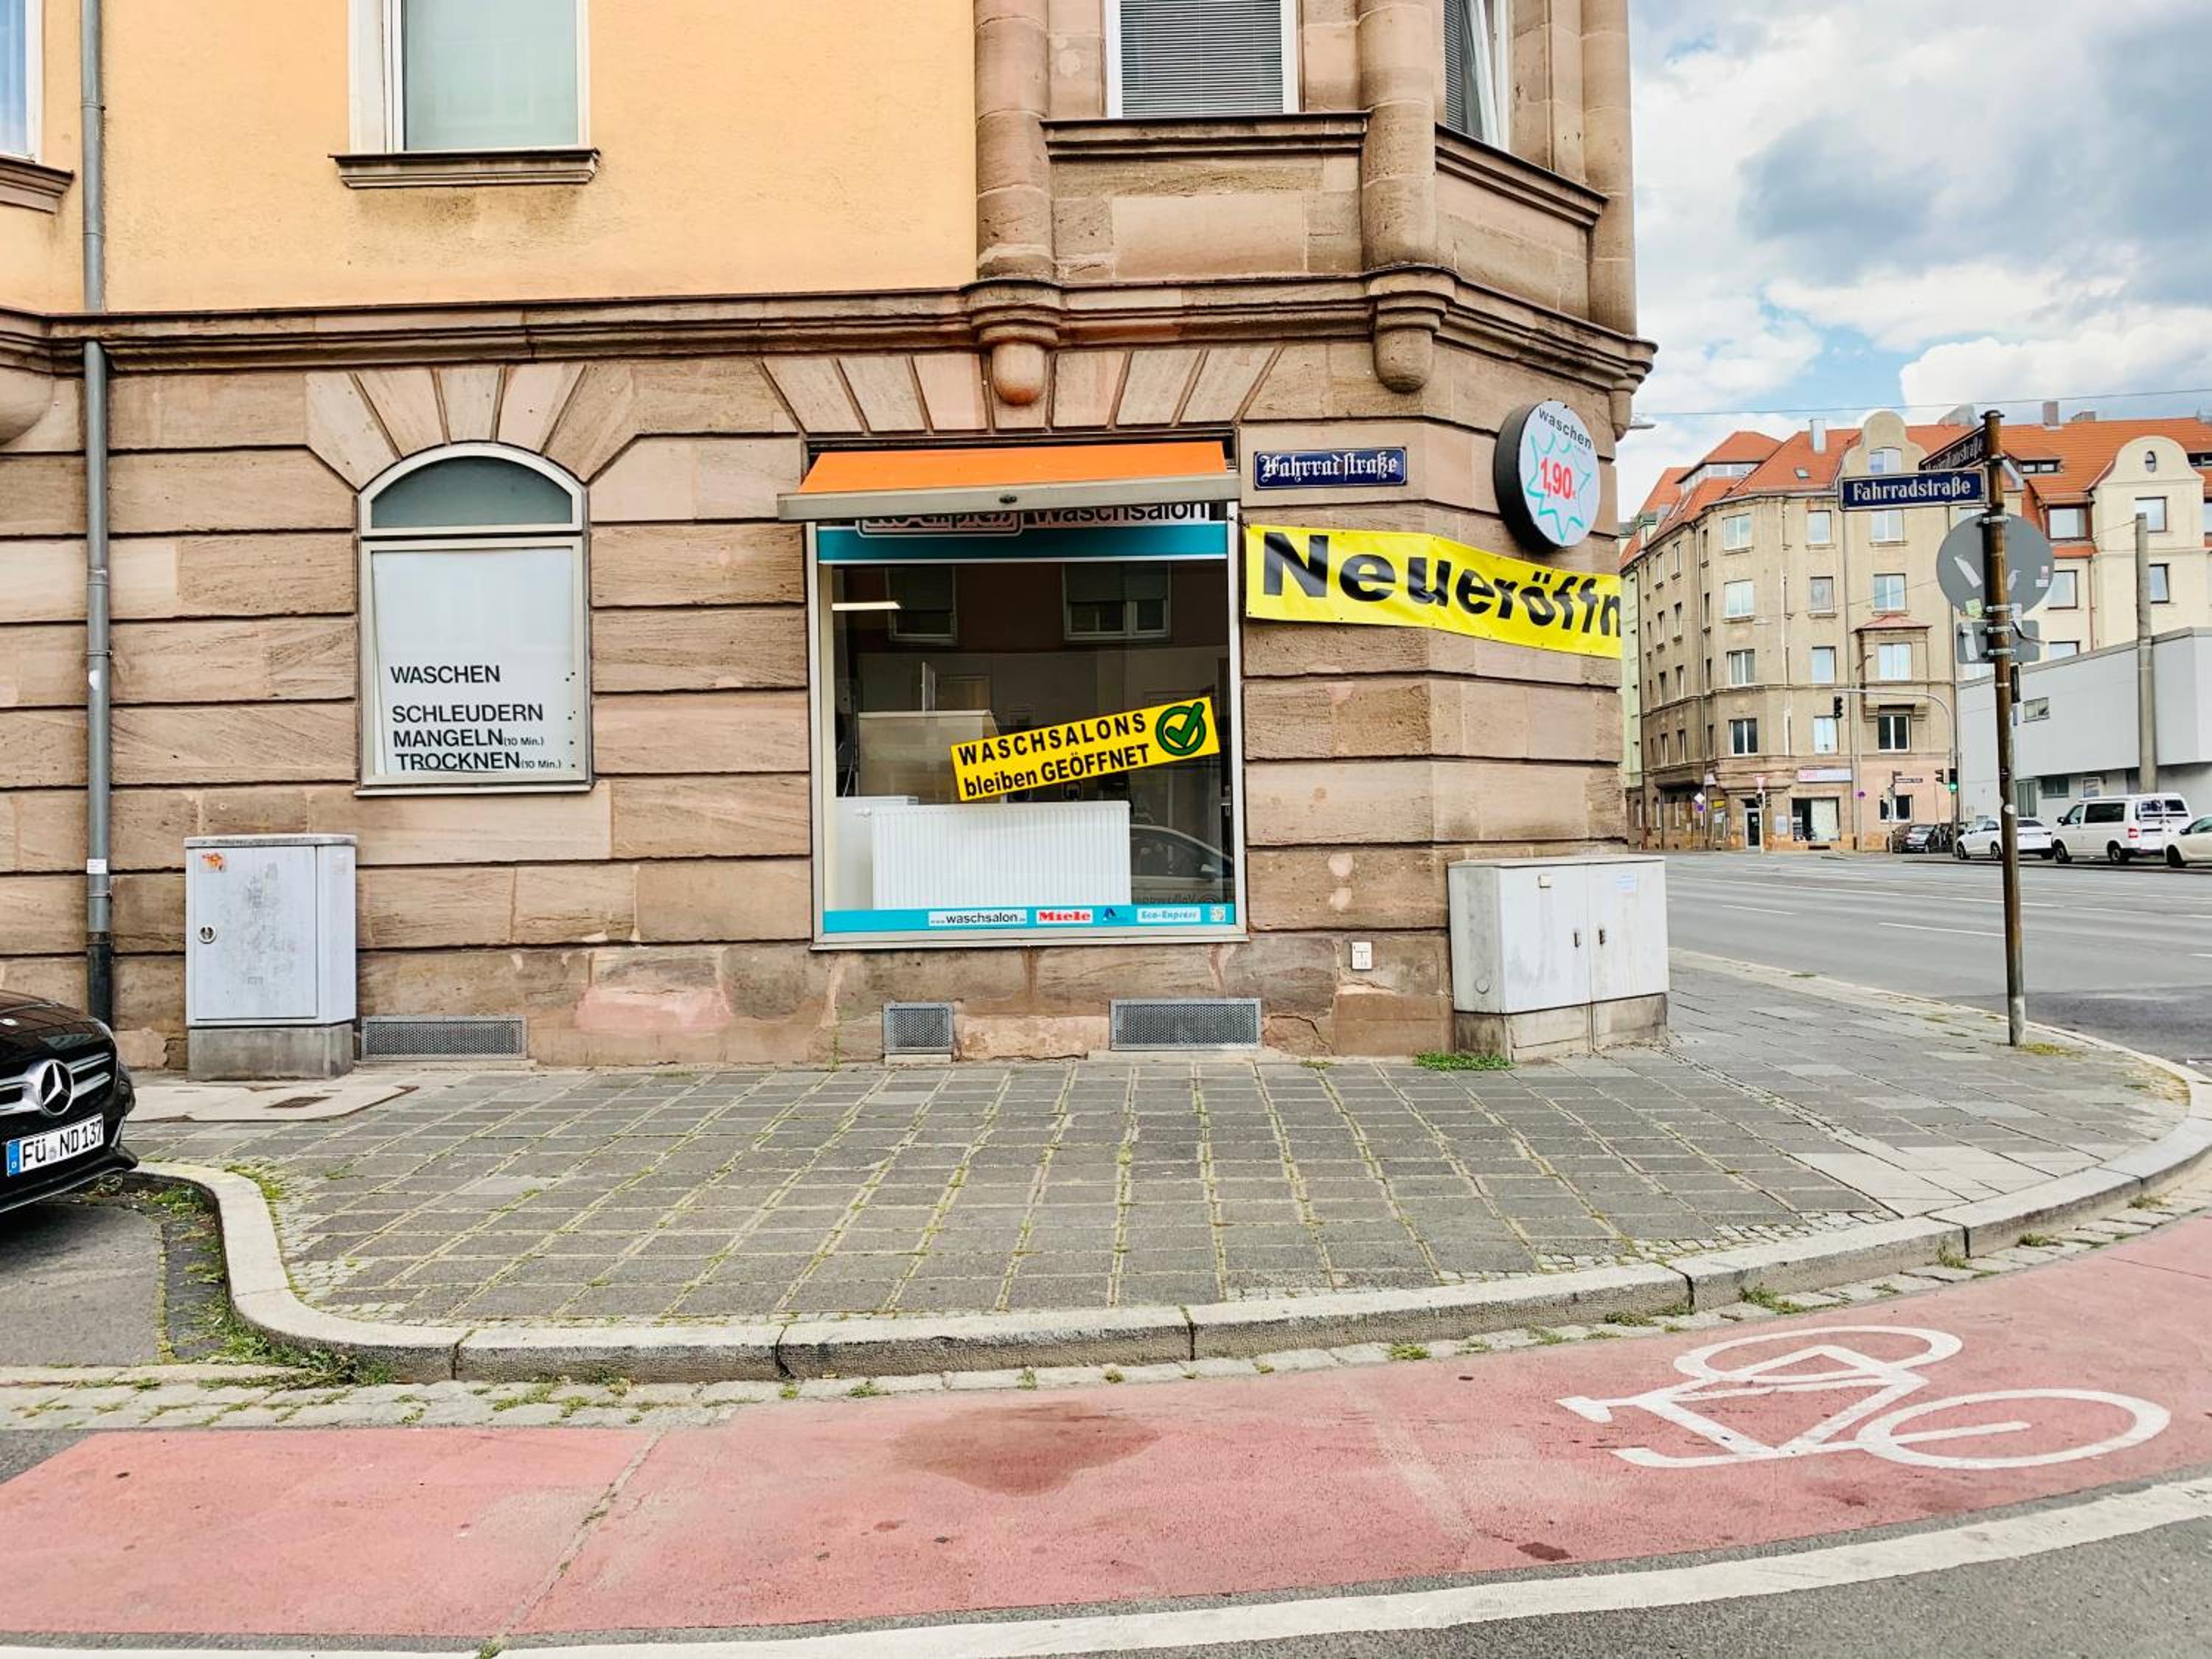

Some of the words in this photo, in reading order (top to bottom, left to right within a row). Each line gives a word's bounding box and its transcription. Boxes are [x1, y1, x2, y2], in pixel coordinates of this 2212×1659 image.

[1539, 408, 1592, 449] waschen
[1540, 457, 1573, 499] 1,90
[1853, 476, 1971, 501] Fahrradstraße
[1263, 531, 1621, 638] Neueröffn
[389, 665, 501, 684] WASCHEN
[392, 703, 543, 723] SCHLEUDERN
[393, 728, 503, 747] MANGELN
[958, 712, 1147, 766] WASCHSALONS
[395, 751, 521, 771] TROCKNEN
[964, 764, 1038, 797] bleiben
[1040, 743, 1150, 782] GEÖFFNET
[1038, 911, 1091, 921] Miele
[23, 1138, 46, 1168] FÜ
[60, 1129, 79, 1157] ND
